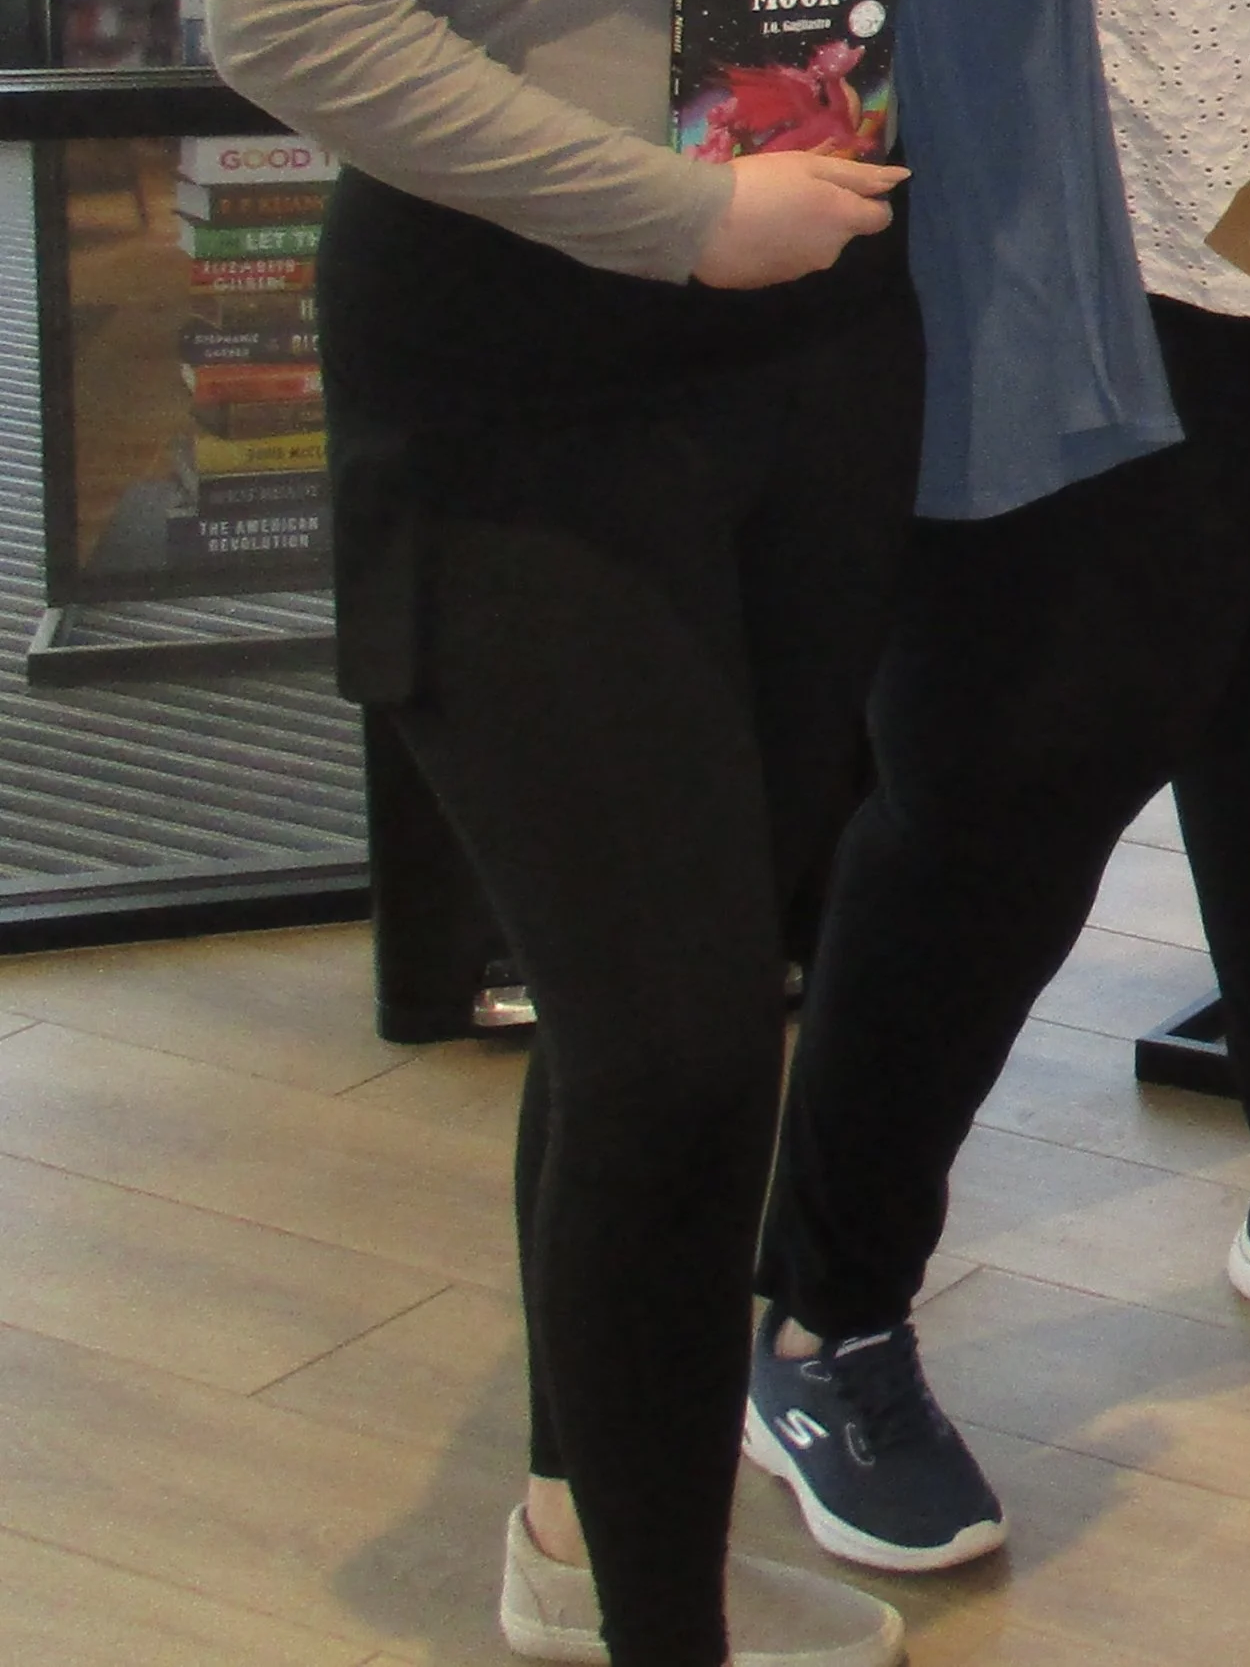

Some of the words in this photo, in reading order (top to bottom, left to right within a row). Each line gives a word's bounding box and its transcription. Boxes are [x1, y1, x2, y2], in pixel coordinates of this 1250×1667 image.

[219, 148, 312, 170] GOOD
[199, 520, 230, 536] THE
[234, 517, 319, 535] AMERICAN
[208, 534, 309, 552] REVOLUTION
